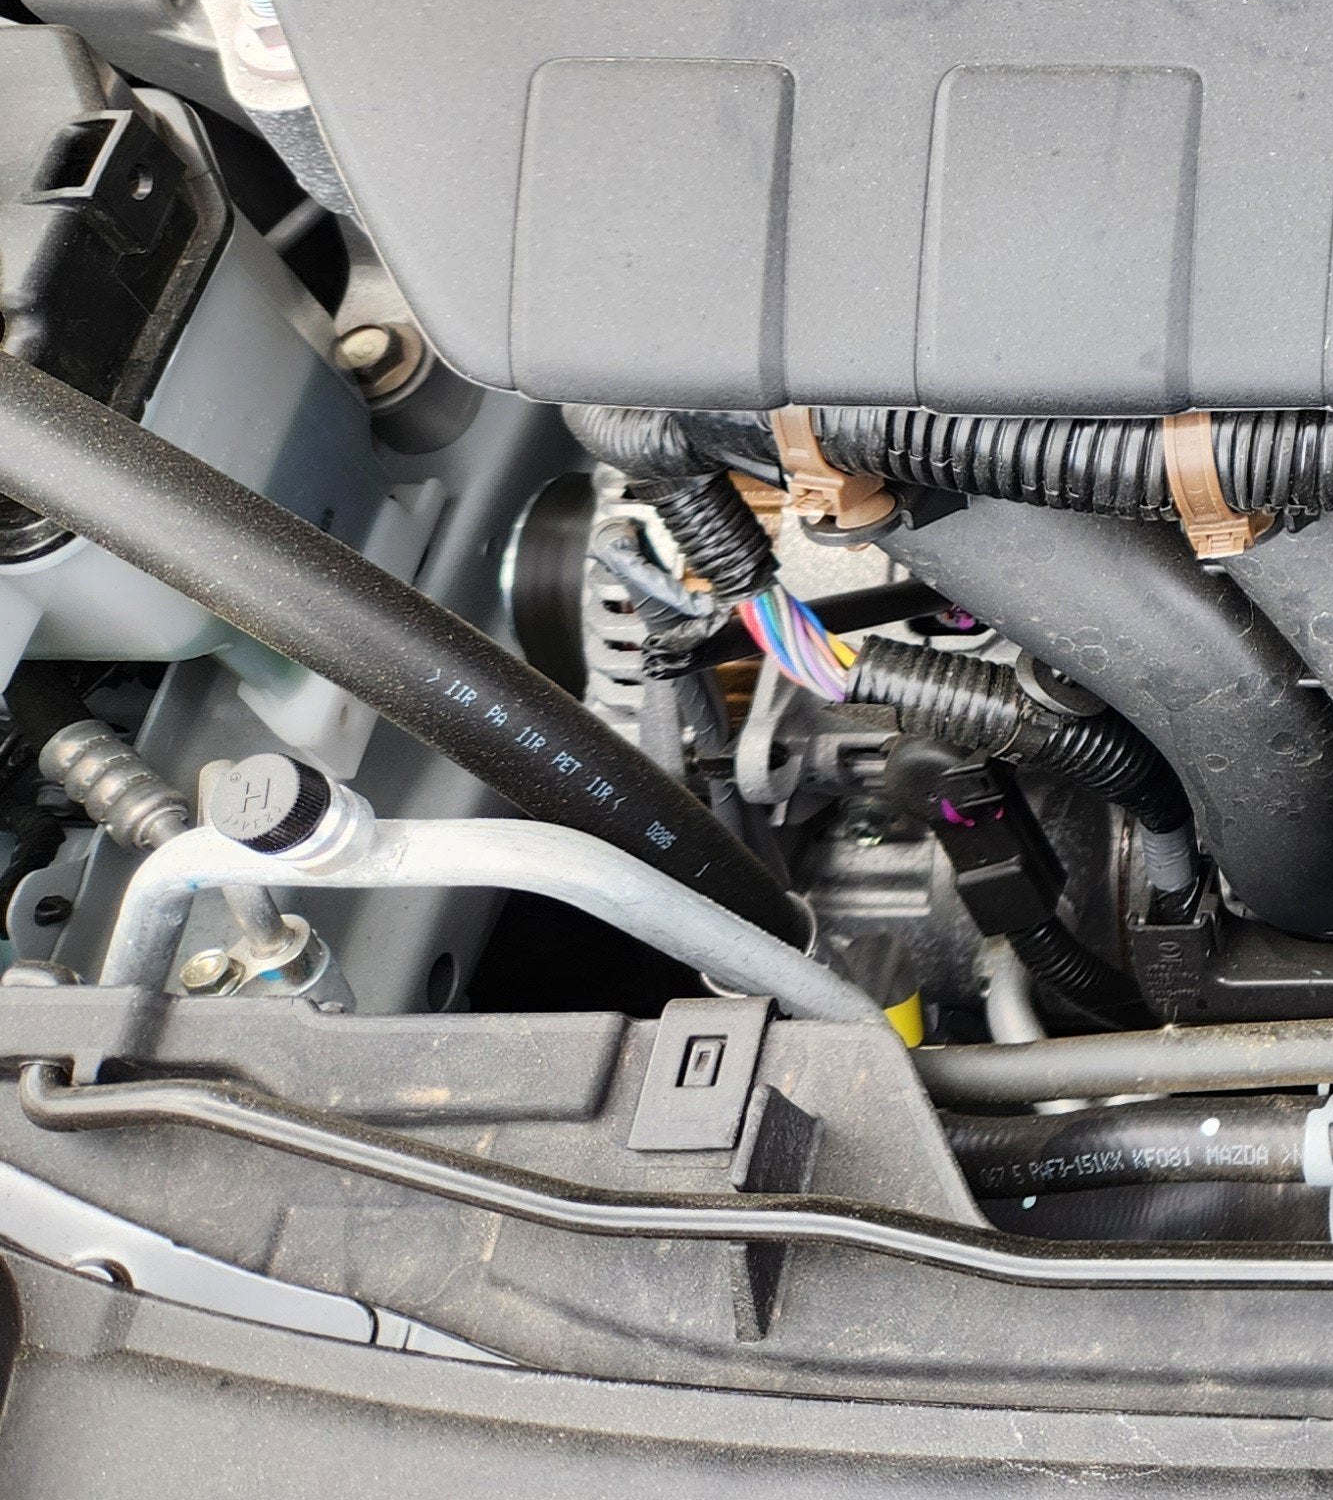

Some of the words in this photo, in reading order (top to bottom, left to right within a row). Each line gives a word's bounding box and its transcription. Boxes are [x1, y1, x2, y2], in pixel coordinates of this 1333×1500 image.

[484, 704, 508, 728] PA
[551, 750, 583, 776] PET
[1206, 1144, 1269, 1166] MAZDA
